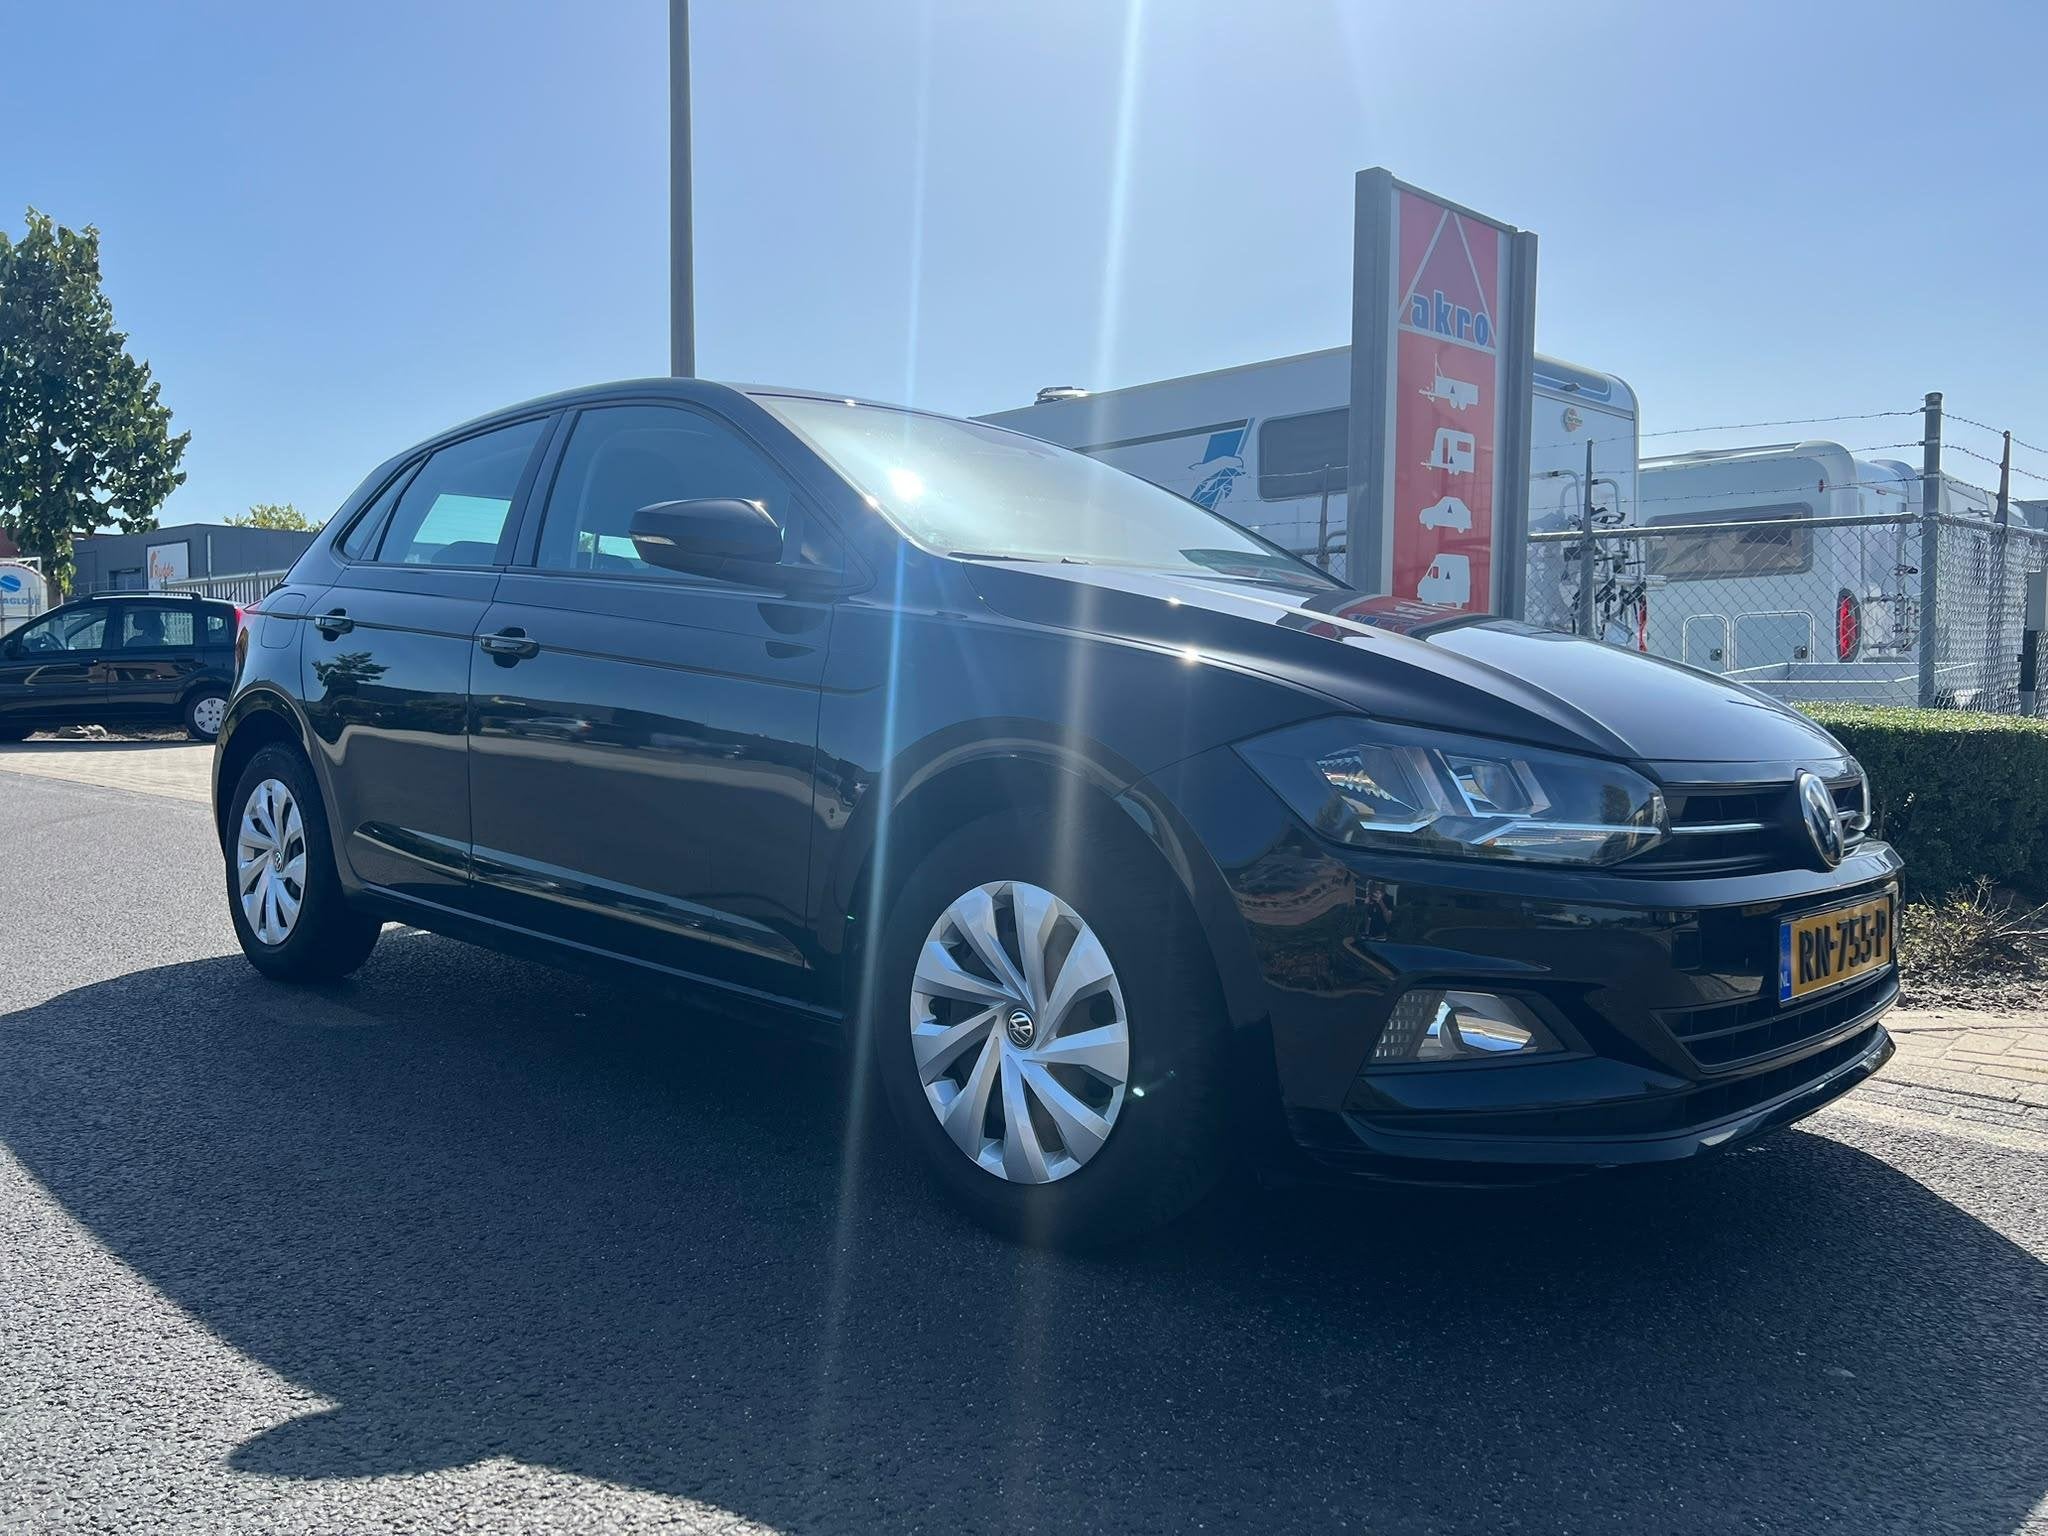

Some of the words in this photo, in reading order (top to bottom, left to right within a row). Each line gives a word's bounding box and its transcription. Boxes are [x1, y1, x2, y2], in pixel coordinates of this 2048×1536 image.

[1410, 289, 1490, 347] akro
[1798, 909, 1887, 985] RN-755-P
[1779, 970, 1790, 989] NL
